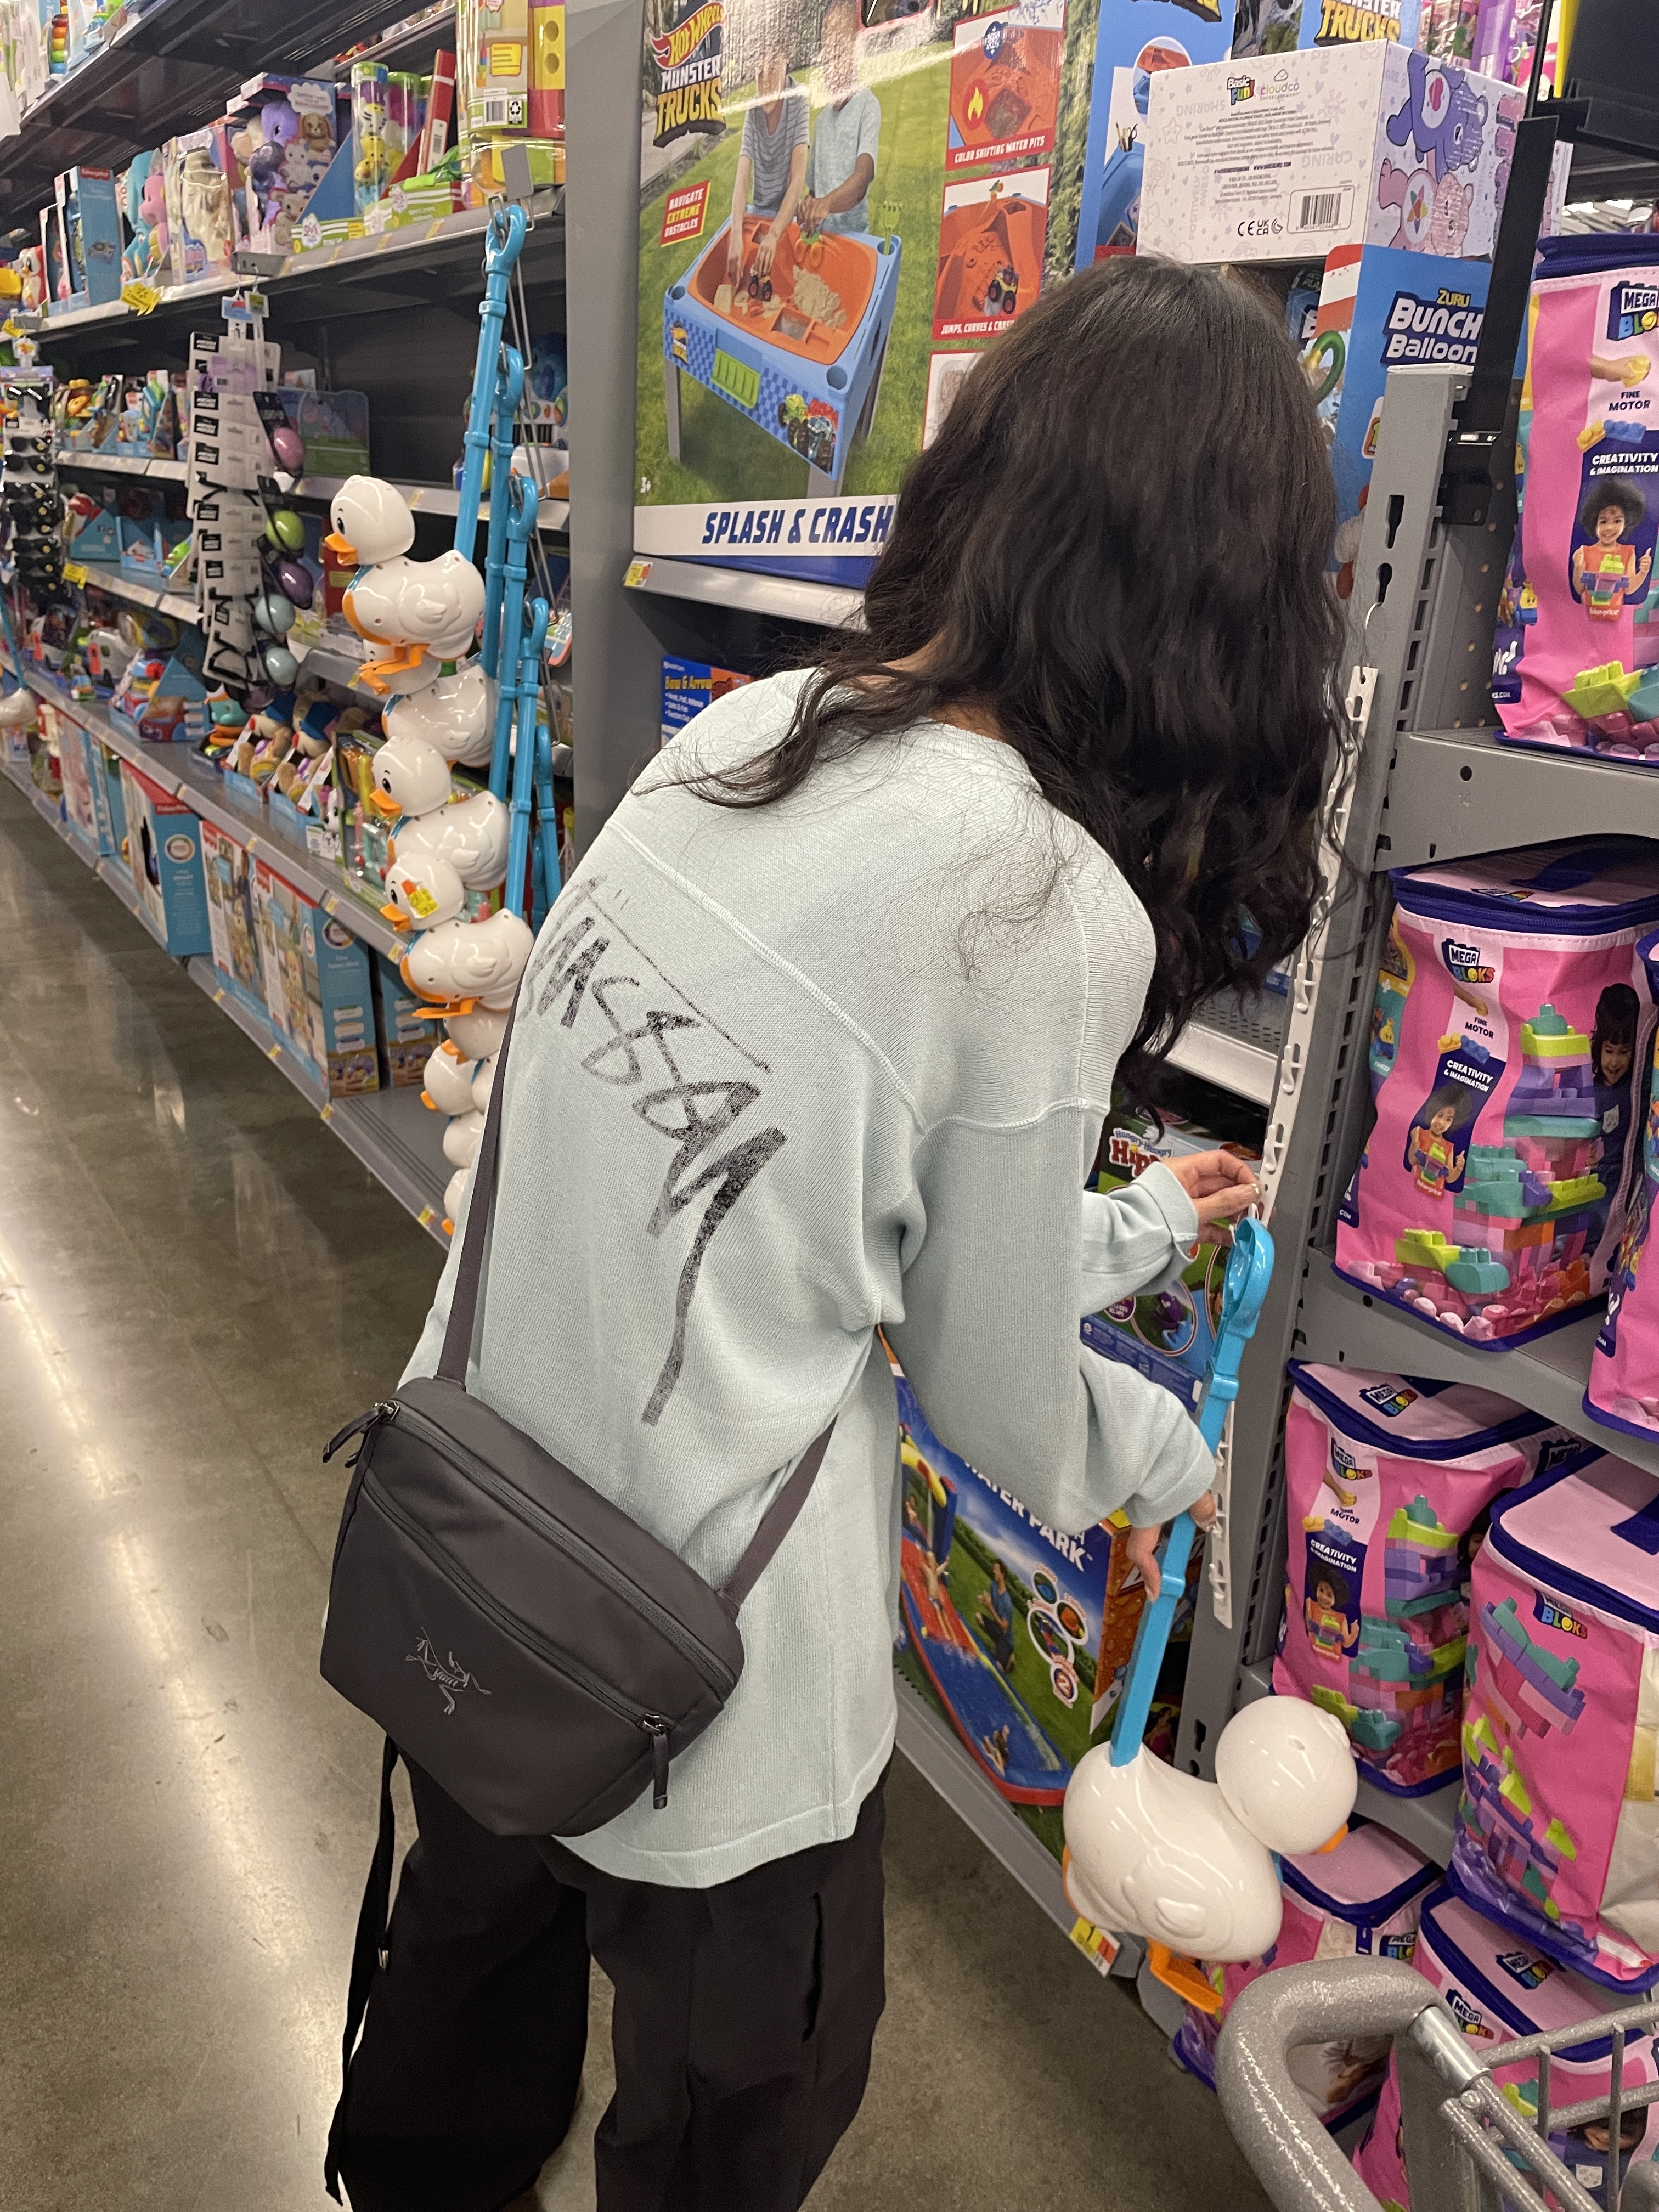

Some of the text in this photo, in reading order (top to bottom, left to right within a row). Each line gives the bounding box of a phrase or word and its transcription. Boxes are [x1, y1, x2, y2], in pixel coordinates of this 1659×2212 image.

[1315, 0, 1401, 43] TRUCKS
[668, 28, 691, 66] HOT
[661, 54, 722, 92] MONSTER
[1227, 75, 1250, 89] Basic
[1261, 82, 1300, 95] cloudco
[653, 76, 726, 140] TRUCKS
[955, 136, 1046, 163] COLOR SHIFTING WATER PITS
[668, 188, 705, 211] NAVIGATE
[1436, 289, 1471, 307] ZURU
[1623, 291, 1656, 311] MEGA
[1617, 311, 1659, 340] BLO
[1621, 391, 1640, 399] FINE
[1609, 400, 1651, 412] MOTOR
[1592, 452, 1659, 465] CREATIVITY
[1596, 464, 1659, 476] IMAGINATION
[702, 505, 895, 544] SPLASH & CRASH
[1450, 947, 1477, 964] MEGA
[1452, 965, 1496, 983] BLOKS
[1465, 1022, 1494, 1039] MOTOR
[1447, 1059, 1494, 1084] CREATIVITY
[1449, 1071, 1490, 1093] IMAGINATION
[1115, 1130, 1144, 1147] Hungry
[1335, 1447, 1353, 1467] MEGA
[1330, 1508, 1361, 1525] MOTOR
[1310, 1539, 1357, 1564] CREATIVITY
[1541, 1605, 1588, 1639] BLOKS
[1454, 2001, 1480, 2024] MEGA
